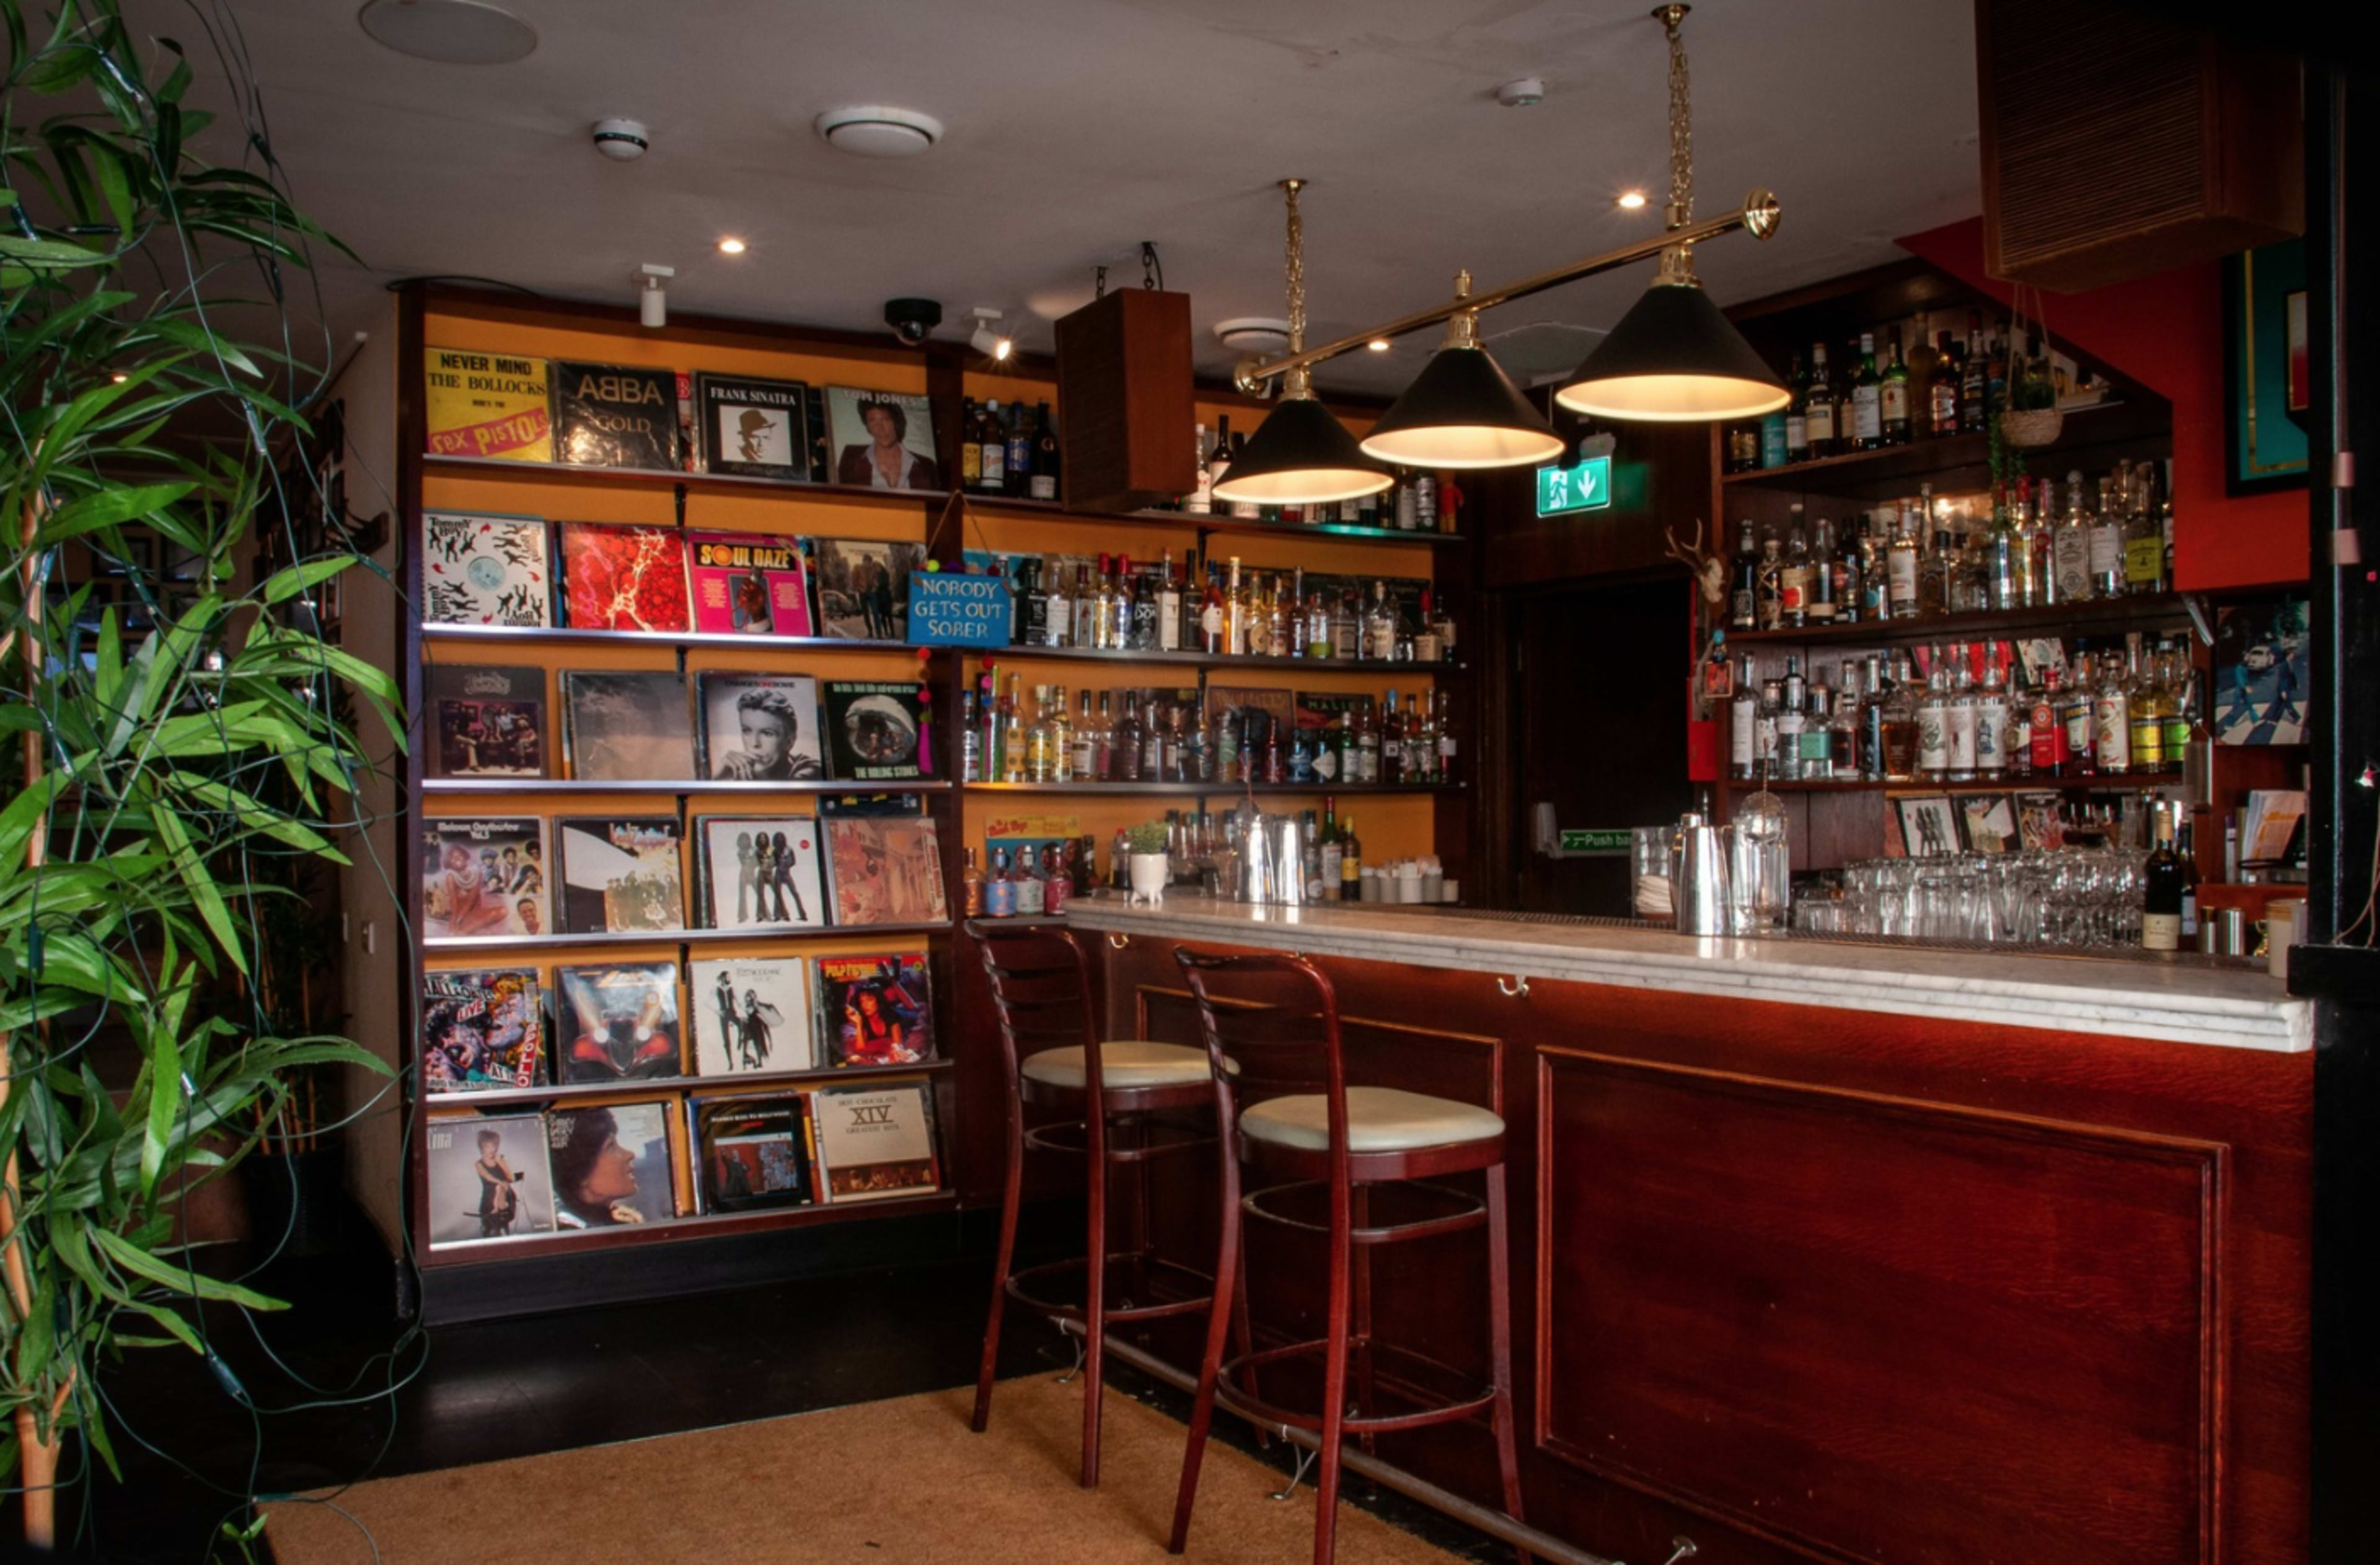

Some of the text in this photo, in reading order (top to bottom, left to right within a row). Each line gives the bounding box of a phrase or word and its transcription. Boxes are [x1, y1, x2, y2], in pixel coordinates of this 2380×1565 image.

[441, 353, 532, 376] NEVER MIND
[429, 373, 546, 396] THE BOLLOCKS
[576, 373, 665, 406] ABBA
[711, 387, 797, 406] FRANK SINATRA
[843, 389, 917, 406] TOM JONES
[595, 415, 651, 433] GOLD
[700, 544, 790, 570] SOUL DAZE
[922, 578, 999, 600] NOBODY
[914, 600, 1004, 619] GETS OUT
[927, 618, 989, 639] SOBER
[1585, 834, 1614, 847] Push
[848, 1104, 894, 1126] XIV
